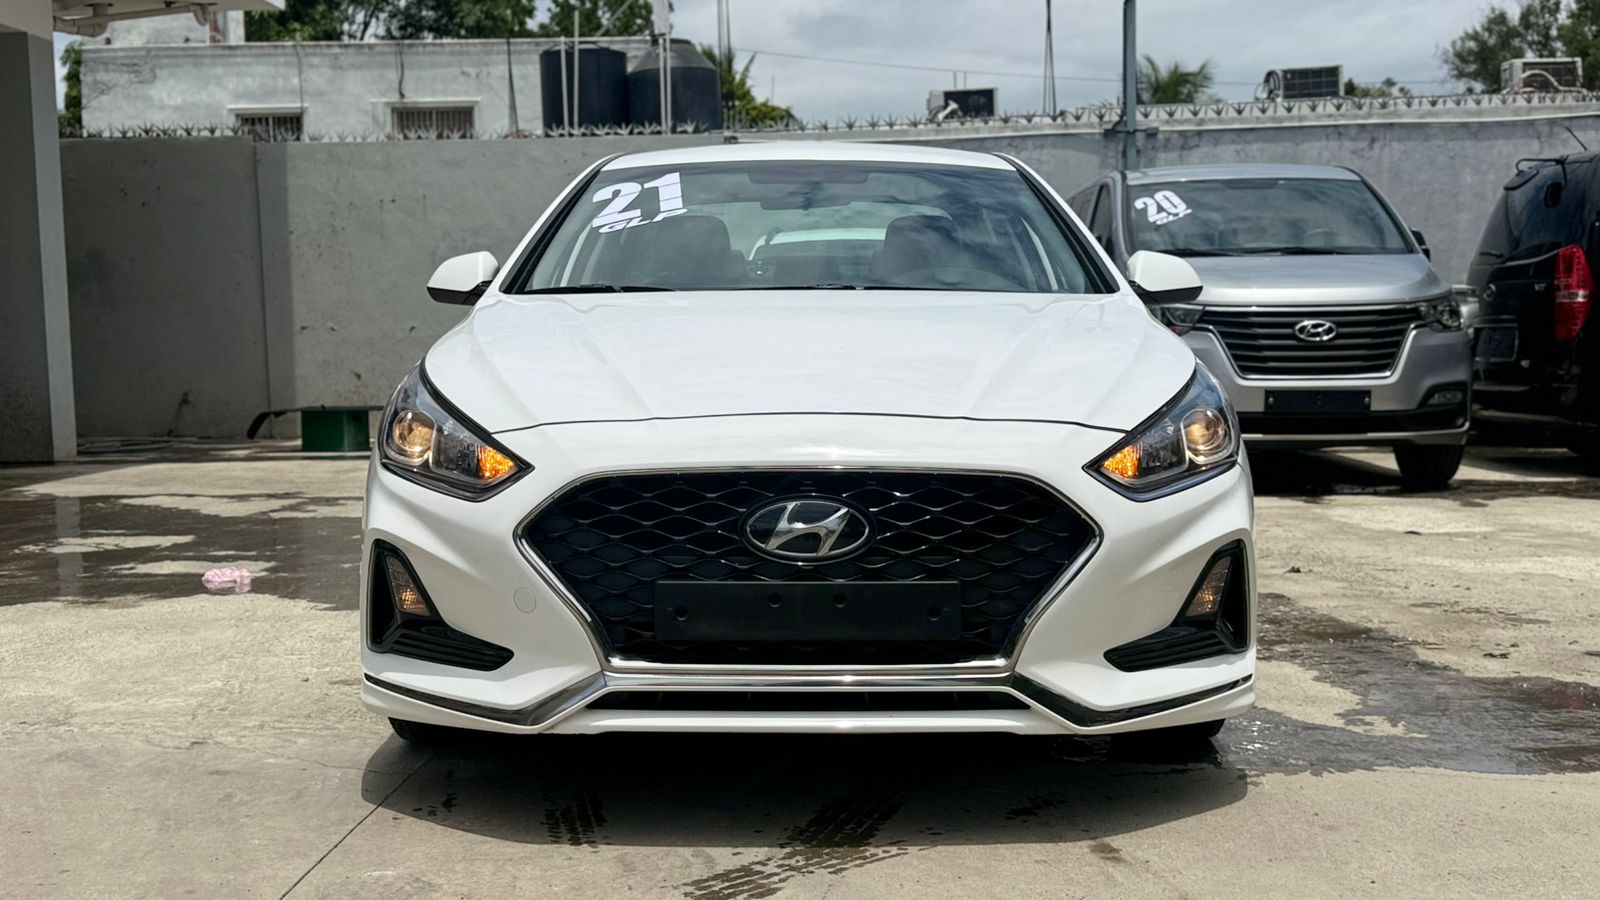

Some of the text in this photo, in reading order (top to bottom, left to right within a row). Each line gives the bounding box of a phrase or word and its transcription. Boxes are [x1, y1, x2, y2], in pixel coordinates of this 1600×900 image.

[592, 172, 684, 228] 21
[1134, 190, 1187, 222] 20
[598, 208, 689, 233] GLP
